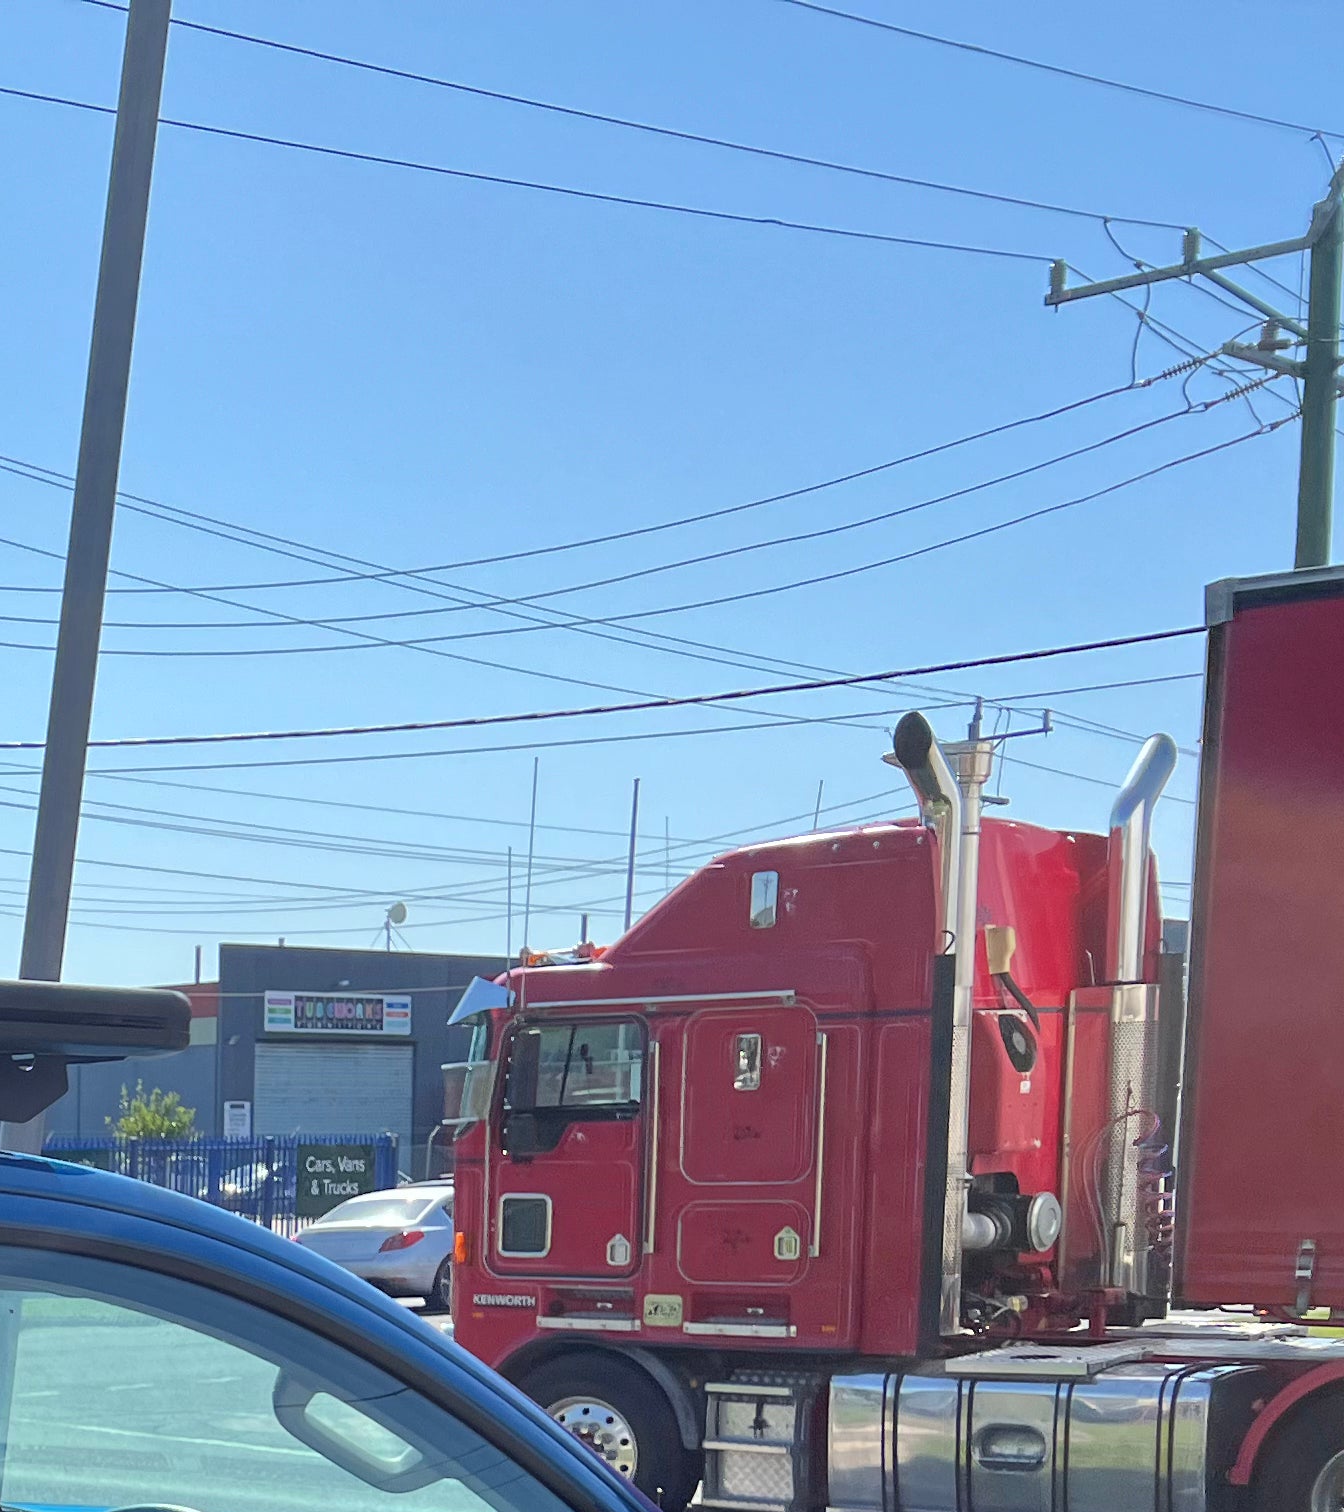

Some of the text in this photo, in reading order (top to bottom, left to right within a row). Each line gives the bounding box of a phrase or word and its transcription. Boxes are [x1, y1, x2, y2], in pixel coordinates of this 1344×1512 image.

[306, 1155, 365, 1174] Cars, Vans
[311, 1179, 359, 1195] & Trucks
[473, 1293, 536, 1307] KENWORTH
